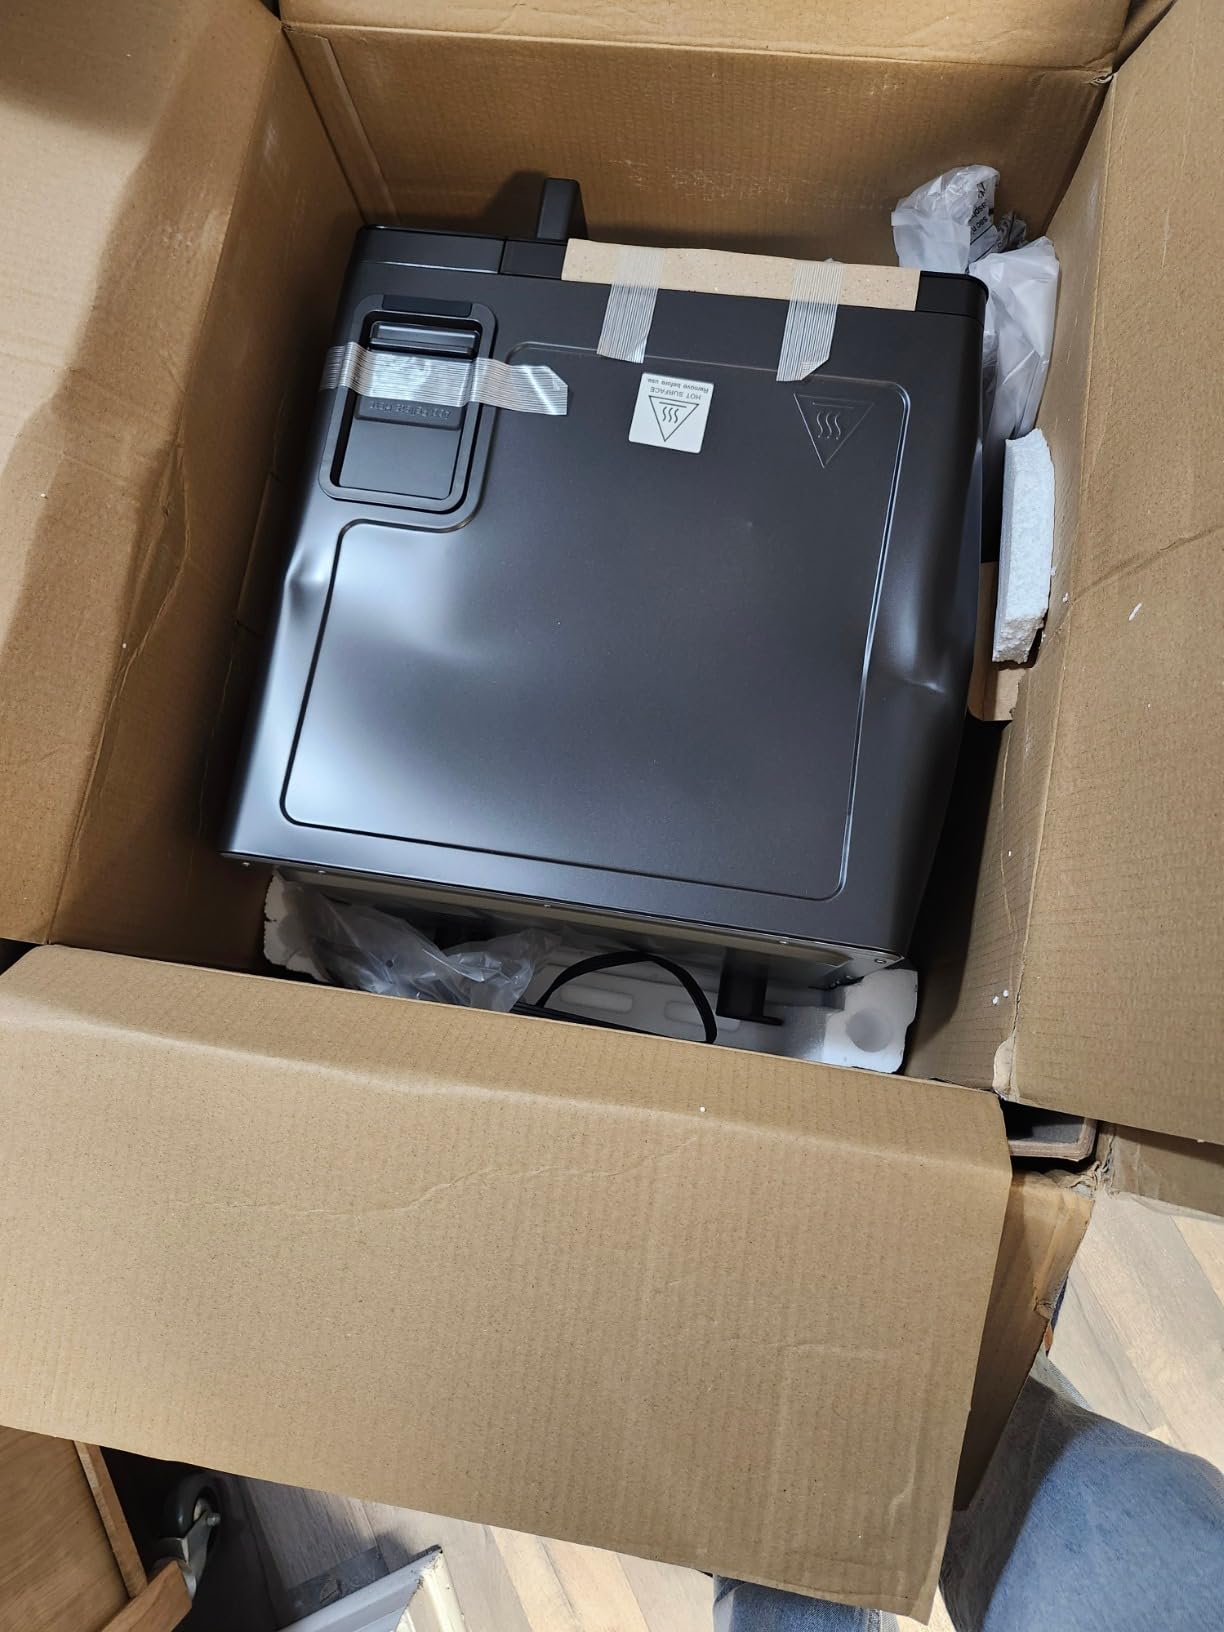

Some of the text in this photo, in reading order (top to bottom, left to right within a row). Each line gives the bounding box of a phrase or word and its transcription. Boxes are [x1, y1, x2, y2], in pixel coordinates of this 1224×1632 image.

[661, 380, 681, 389] before
[683, 384, 709, 394] Remove
[650, 386, 701, 401] HOT SURFACE
